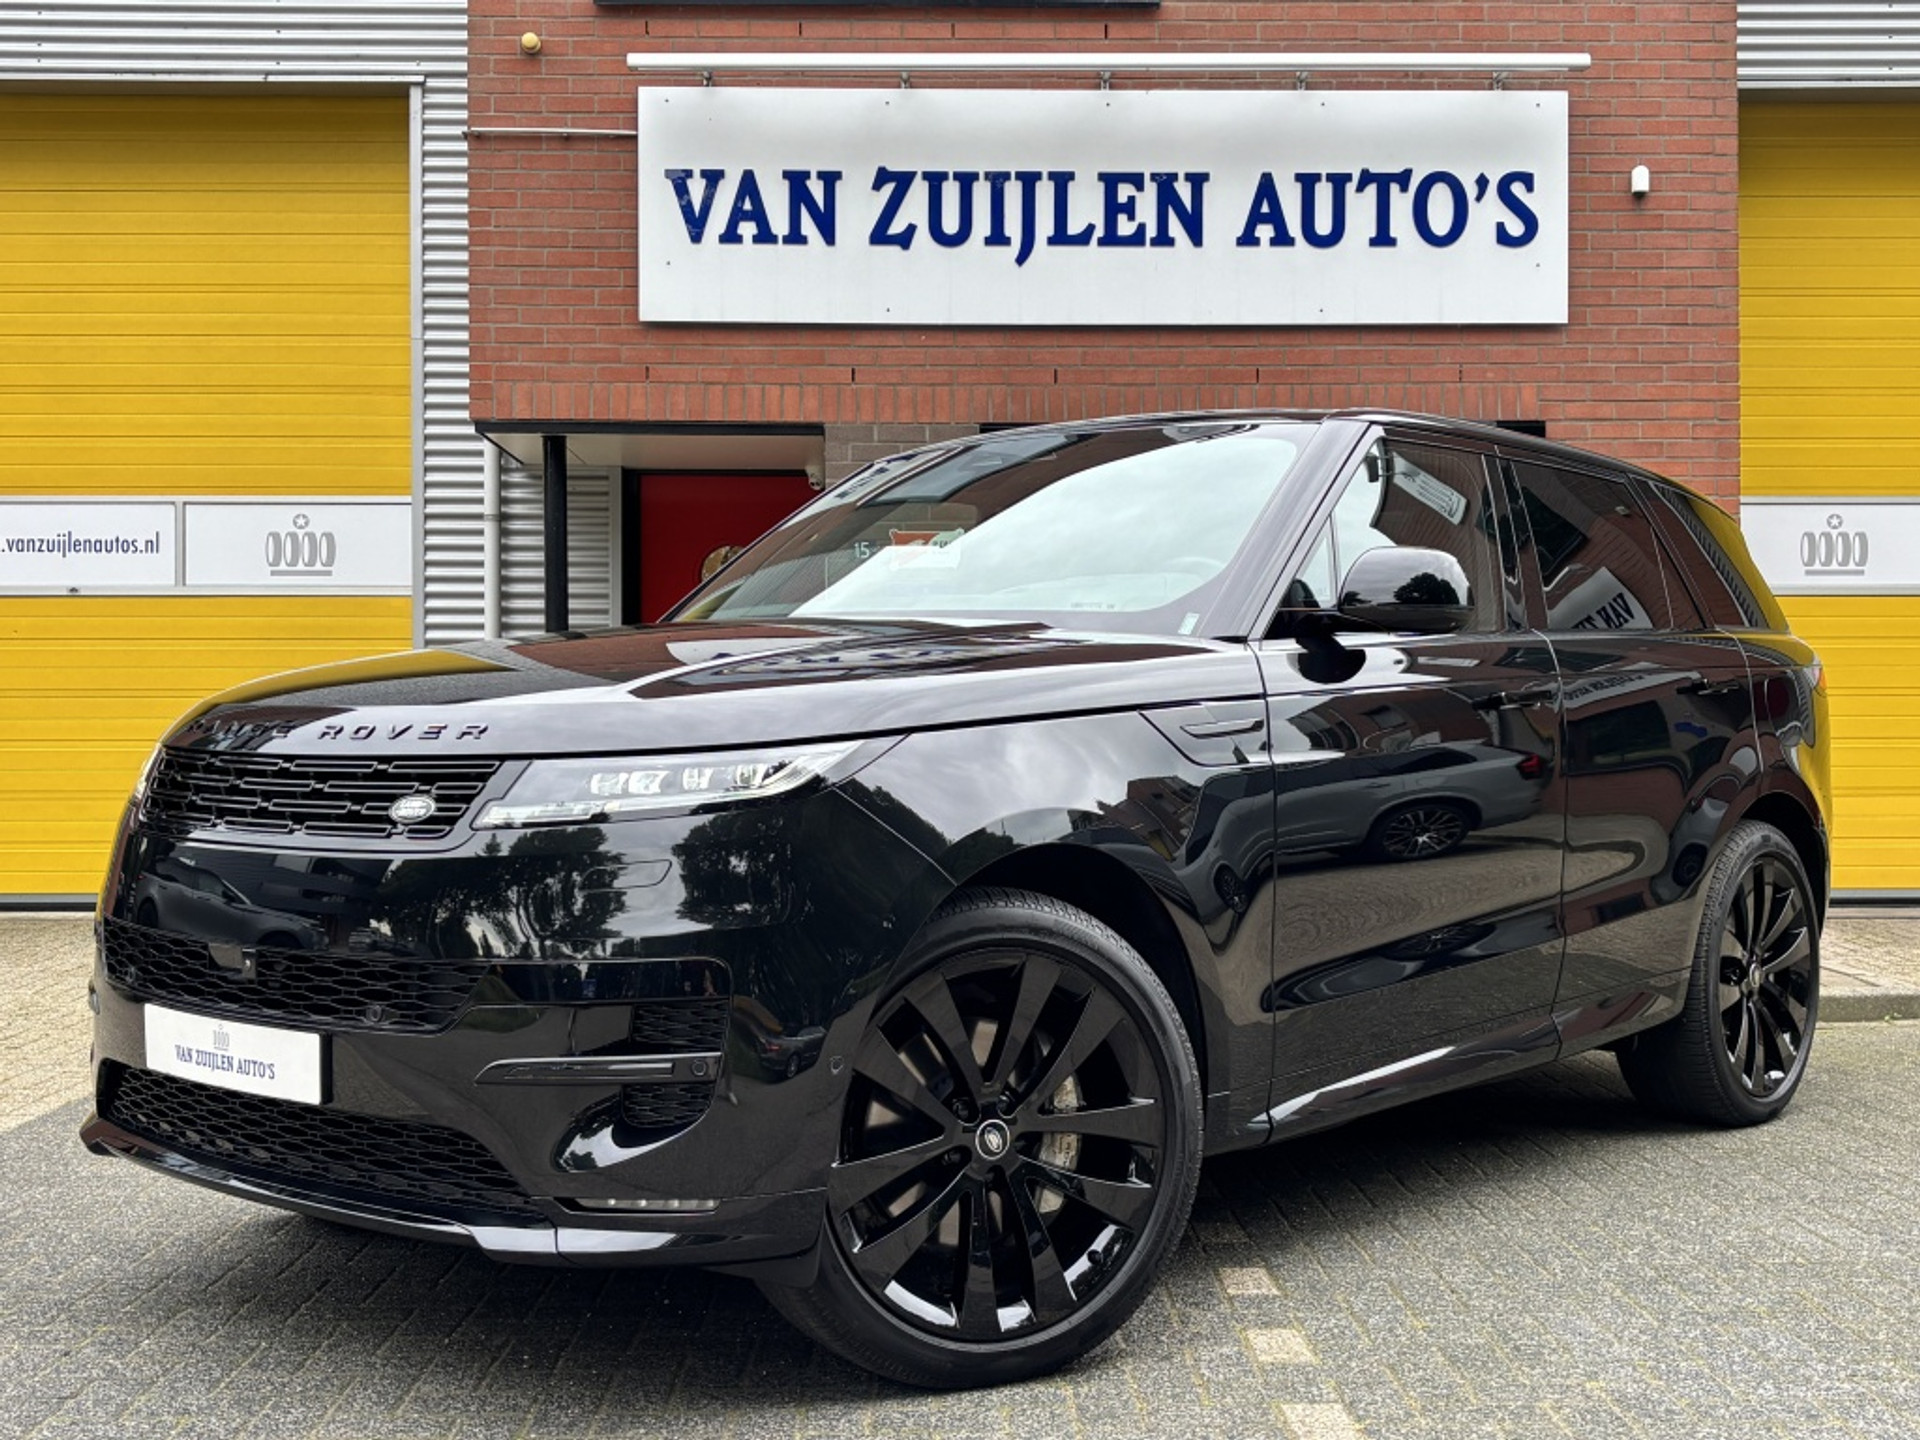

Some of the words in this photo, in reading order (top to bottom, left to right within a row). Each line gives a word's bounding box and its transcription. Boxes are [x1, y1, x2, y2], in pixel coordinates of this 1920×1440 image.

[664, 168, 842, 247] VAN
[870, 166, 1210, 267] ZUIJLEN
[1236, 168, 1540, 248] AUTO'S
[1, 530, 160, 558] .vanzuijlenautos.nl
[317, 723, 490, 741] ROVER
[174, 1044, 193, 1063] VAN
[195, 1049, 234, 1072] ZUIJLEN
[236, 1058, 275, 1080] AUTO'S
